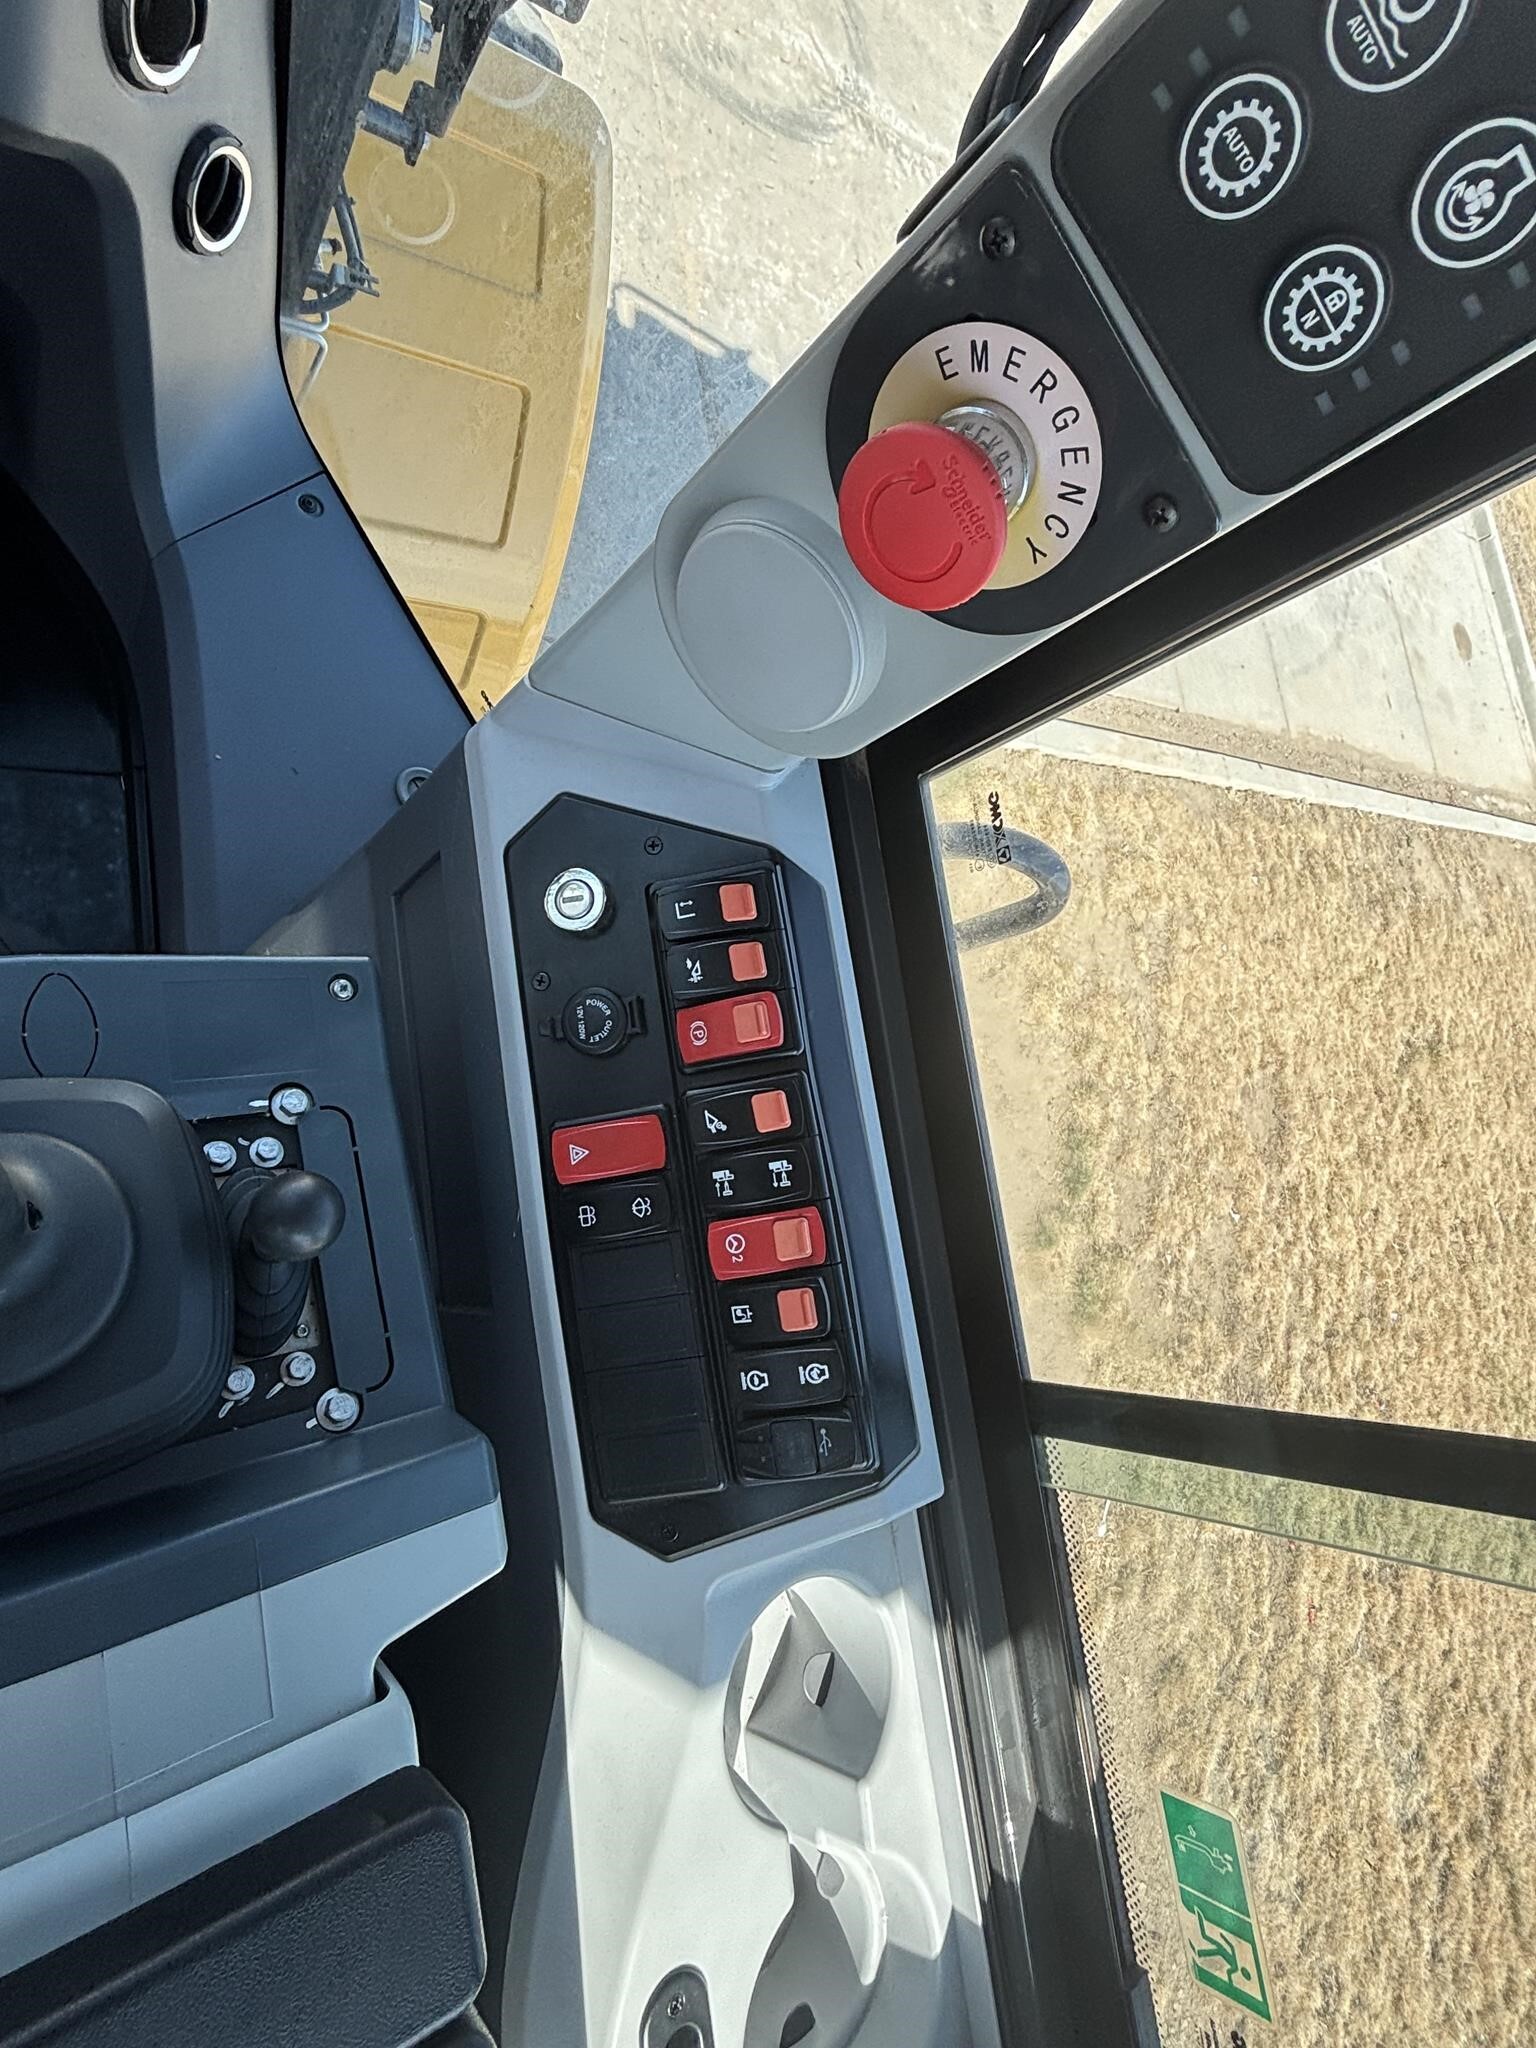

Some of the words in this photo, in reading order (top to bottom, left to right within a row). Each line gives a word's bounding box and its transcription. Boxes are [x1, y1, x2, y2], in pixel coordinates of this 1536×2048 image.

[1346, 14, 1379, 64] AUTO
[1222, 126, 1254, 173] AUTO
[1299, 309, 1321, 330] N
[934, 339, 1090, 564] EMERGENCY
[943, 454, 992, 540] Schneider
[576, 1005, 584, 1019] 12V
[586, 999, 611, 1016] POWER
[578, 1020, 586, 1040] 120W
[589, 1020, 612, 1042] OUTLET
[693, 1029, 704, 1038] P
[732, 1254, 743, 1263] 2
